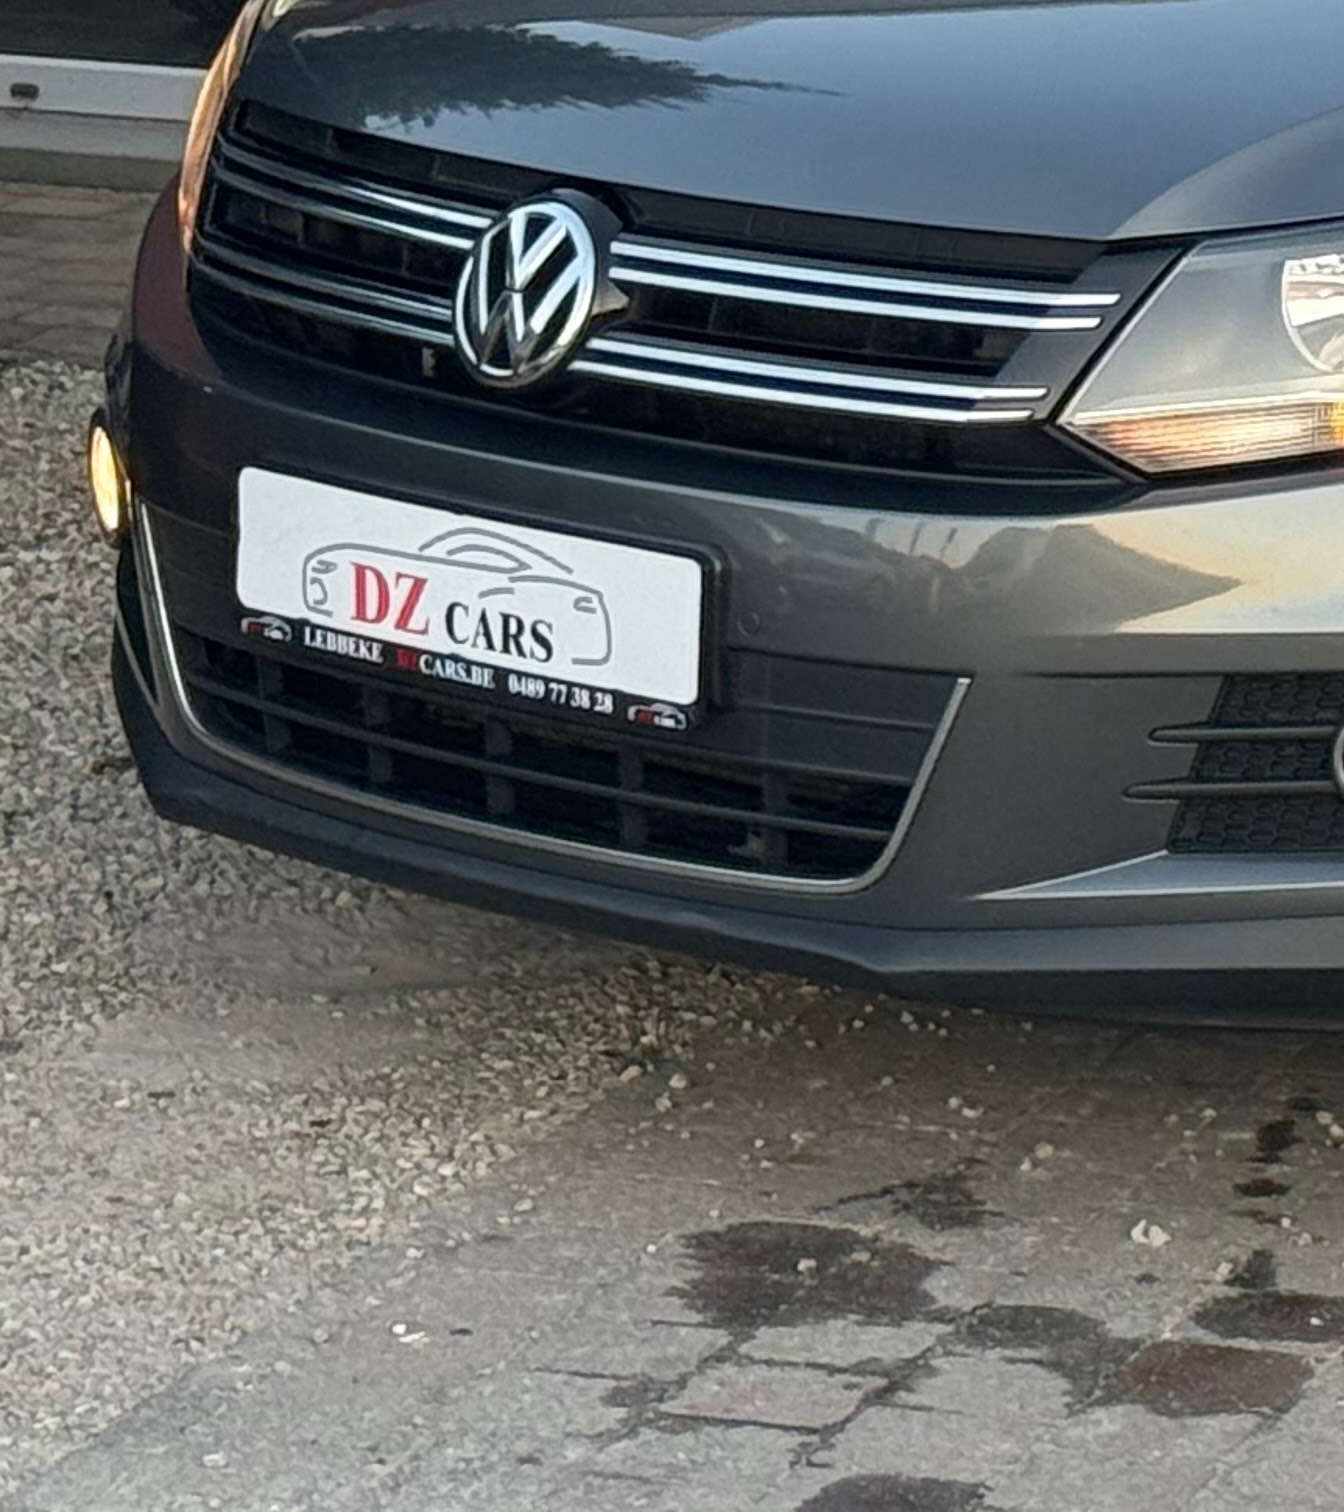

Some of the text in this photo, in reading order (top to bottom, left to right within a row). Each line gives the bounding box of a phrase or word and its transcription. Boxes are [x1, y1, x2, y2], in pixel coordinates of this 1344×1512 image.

[303, 626, 385, 664] LEBBEKE
[349, 561, 431, 636] DZ
[444, 600, 555, 663] CARS
